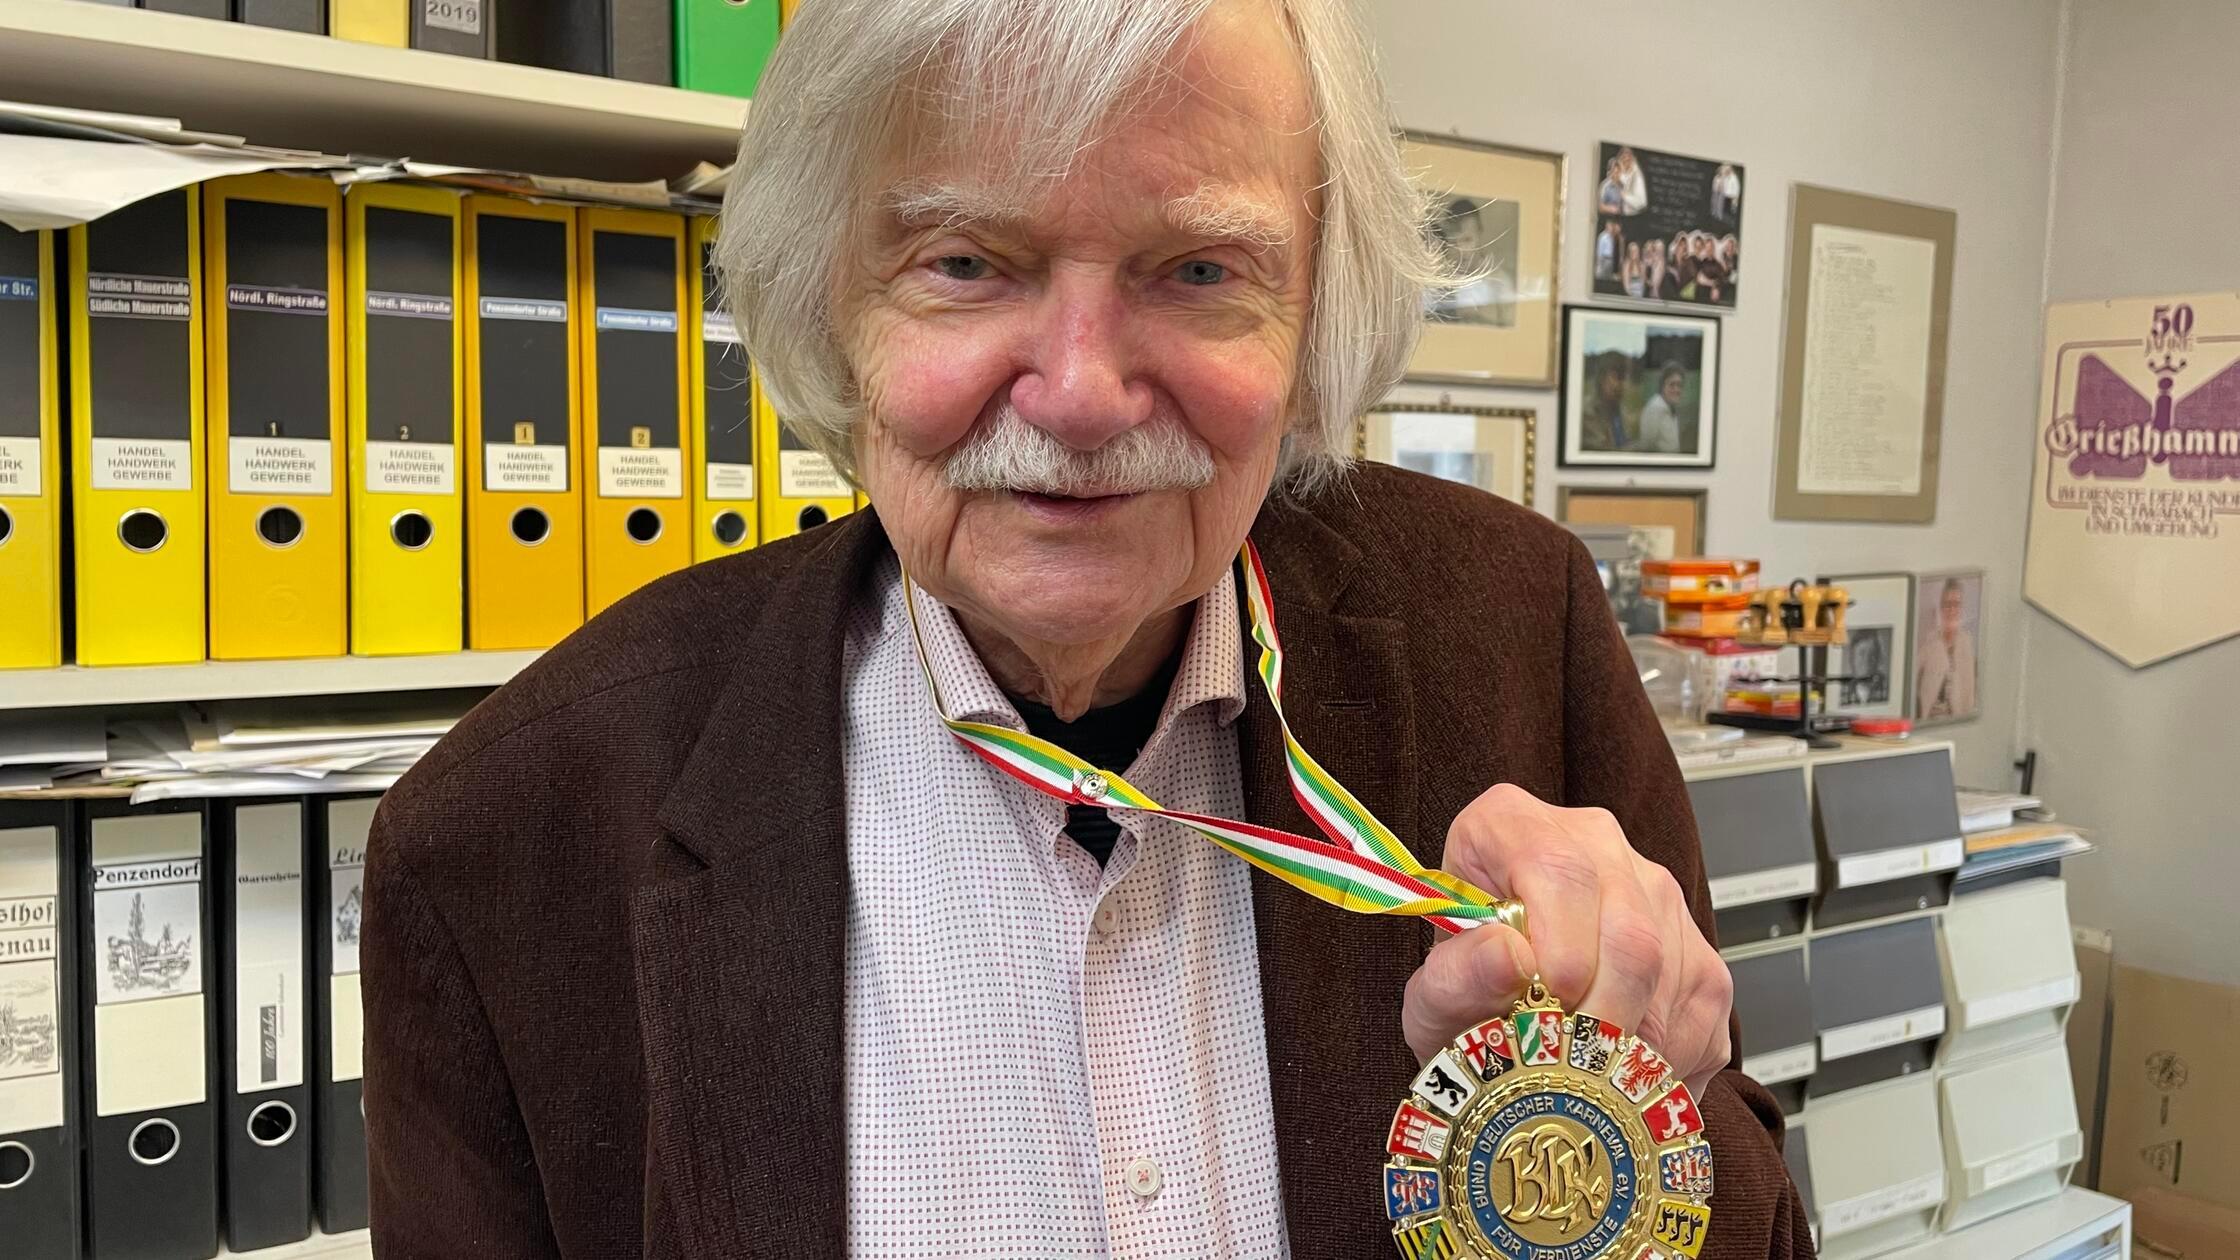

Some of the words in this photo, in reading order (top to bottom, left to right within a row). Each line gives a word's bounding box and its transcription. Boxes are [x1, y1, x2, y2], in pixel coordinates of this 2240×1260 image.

[428, 0, 477, 23] 2019
[12, 282, 35, 296] Str.
[89, 277, 132, 293] Nördliche
[133, 279, 189, 296] Mauerstraße
[229, 289, 264, 304] Nördl.
[266, 292, 327, 309] Ringstraße
[367, 296, 399, 310] Nördl.
[399, 299, 450, 313] Ringstraße
[89, 298, 130, 313] Südliche
[131, 300, 189, 316] Mauerstraße
[2152, 303, 2195, 338] 50
[269, 421, 277, 437] 1
[400, 425, 409, 440] 2
[521, 426, 528, 440] 1
[637, 433, 646, 445] 2
[118, 445, 166, 458] HANDEL
[255, 446, 306, 458] HANDEL
[389, 449, 435, 460] HANDEL
[507, 452, 546, 462] HANDEL
[108, 458, 177, 470] HANDWERK
[245, 459, 317, 471] HANDWERK
[620, 455, 660, 465] HANDEL
[379, 461, 445, 473] HANDWERK
[498, 462, 554, 473] HANDWERK
[612, 467, 669, 476] HANDWERK
[112, 470, 173, 481] GEWERBE
[250, 471, 312, 484] GEWERBE
[384, 473, 441, 485] GEWERBE
[502, 472, 551, 482] GEWERBE
[616, 479, 666, 488] GEWERBE
[96, 863, 200, 883] Penzendorf
[1479, 1096, 1556, 1154] DEUTSCHER
[1564, 1097, 1626, 1166] KARNEVAL
[1471, 1160, 1490, 1209] BUND
[1491, 1225, 1522, 1256] FÜR
[1528, 1216, 1618, 1260] VERDIENSTE
